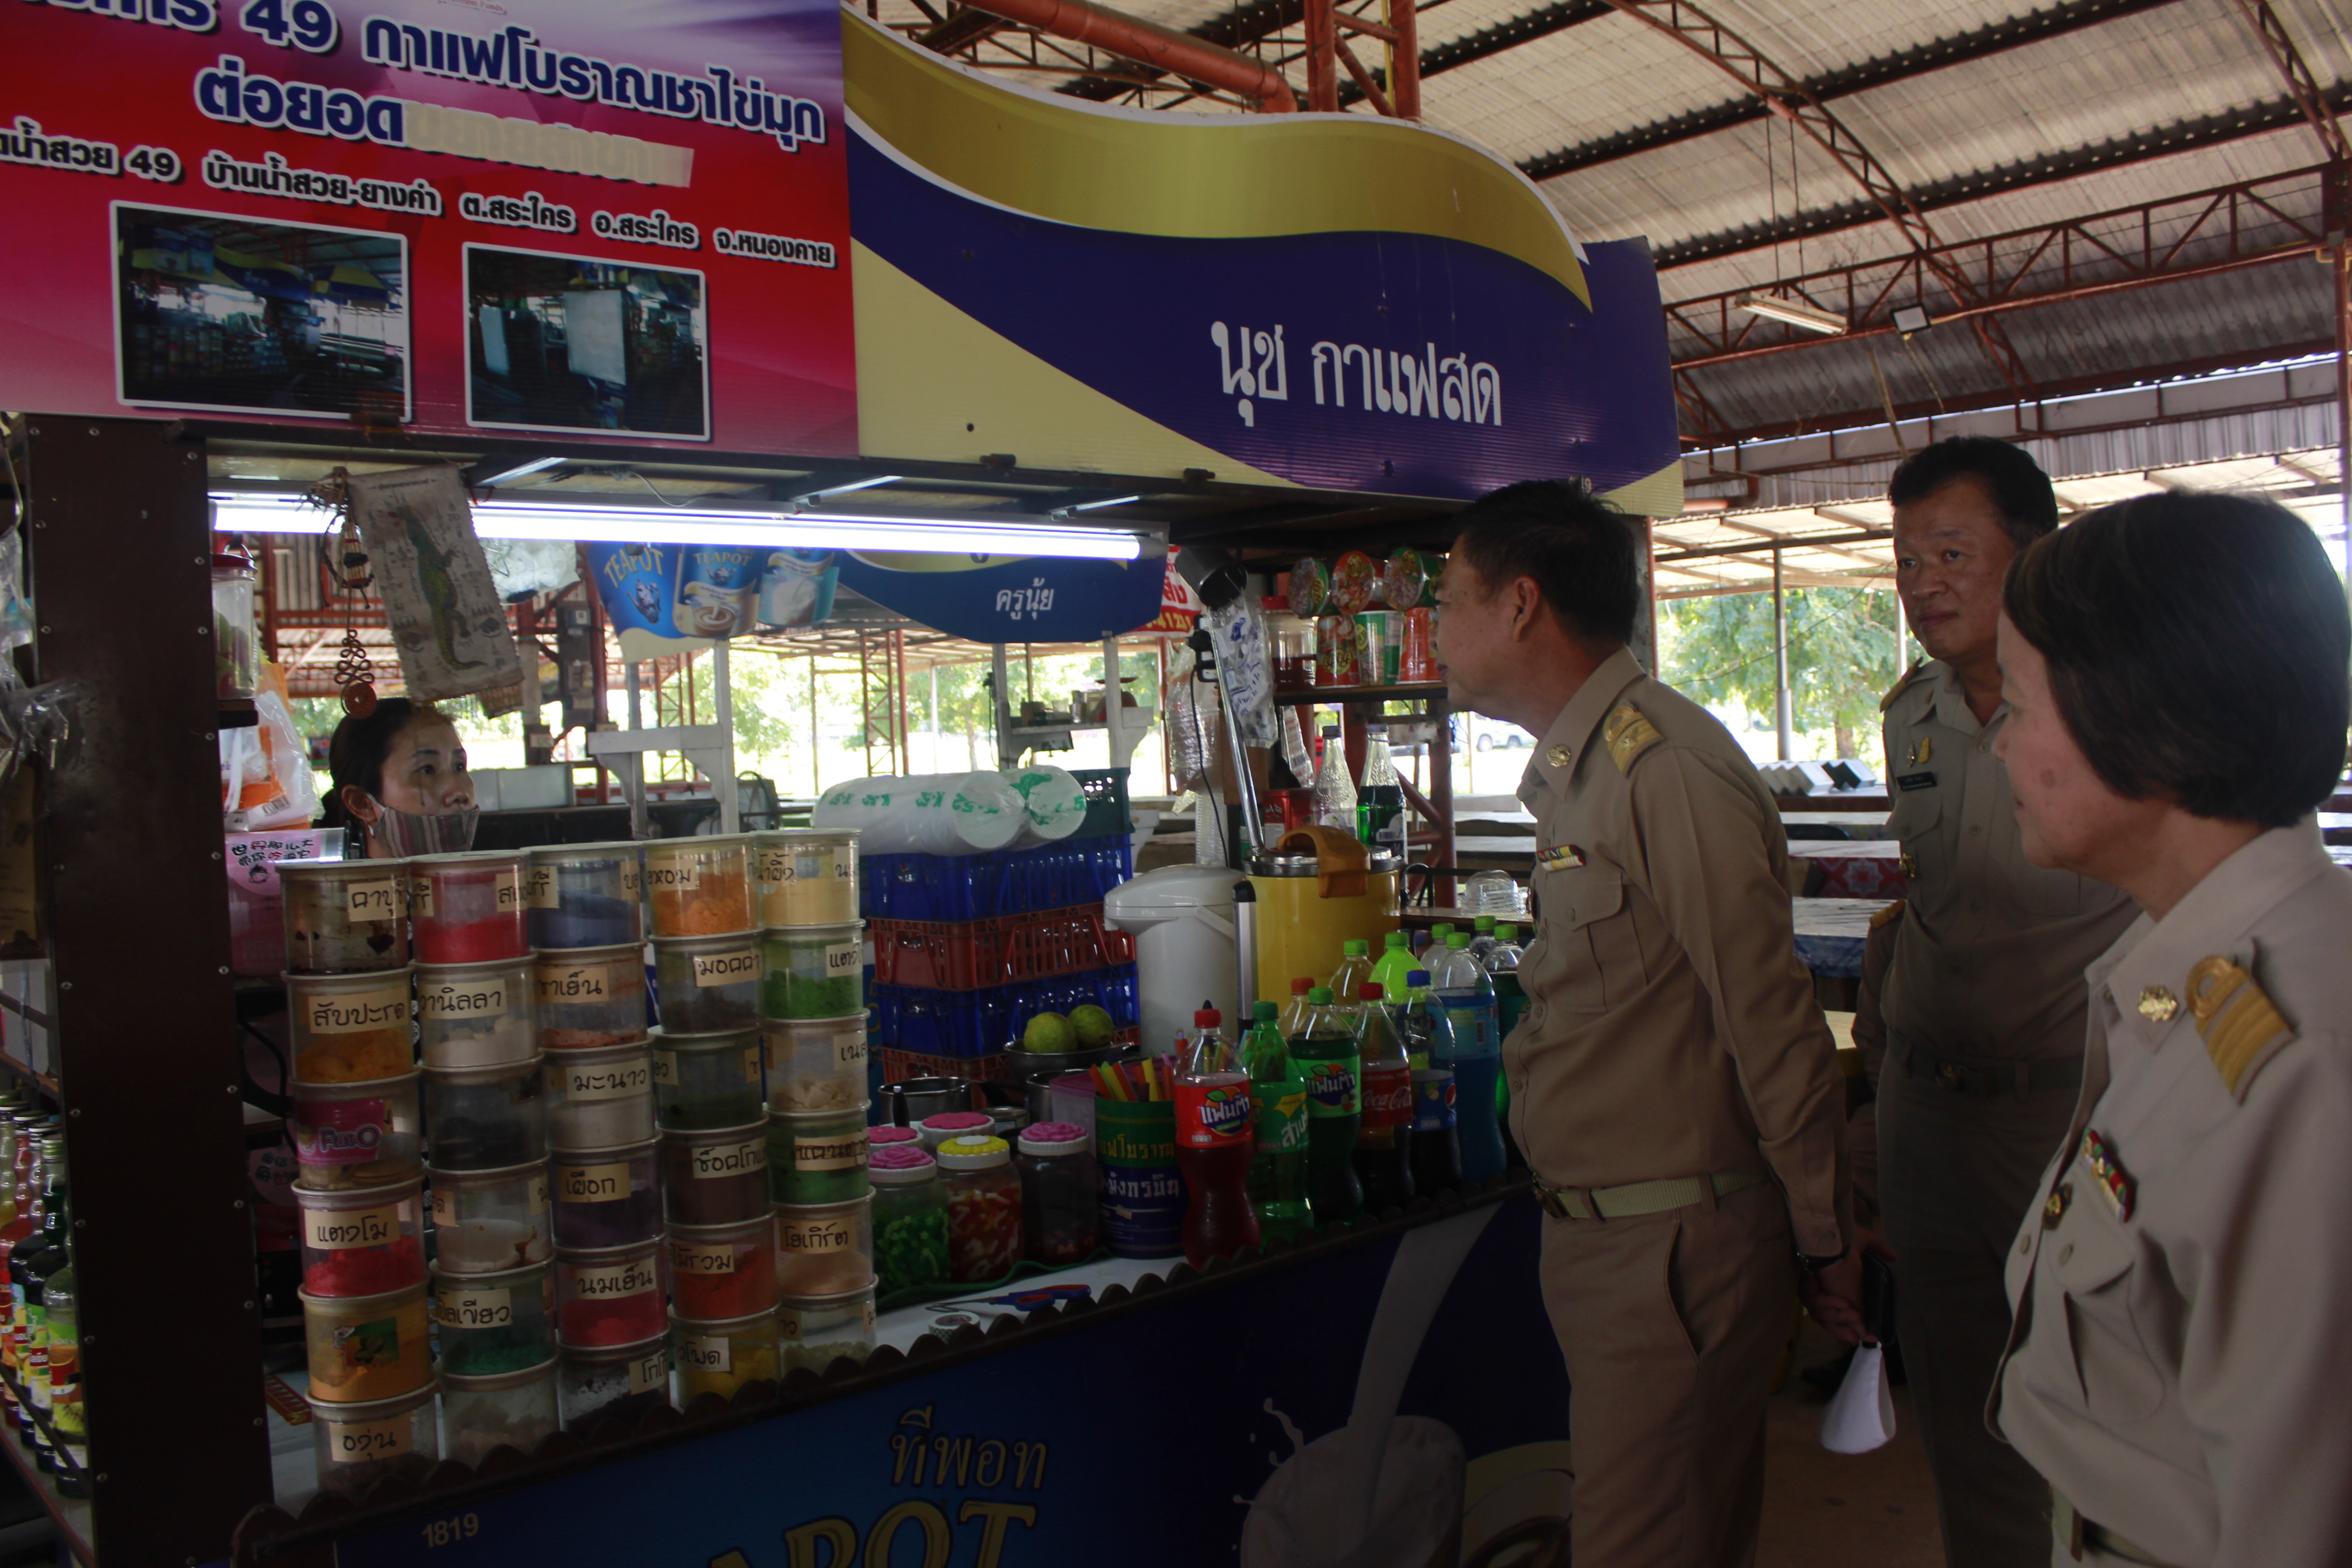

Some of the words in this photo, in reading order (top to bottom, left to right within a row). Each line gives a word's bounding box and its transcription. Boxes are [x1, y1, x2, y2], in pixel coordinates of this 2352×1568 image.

[245, 0, 332, 48] 49
[367, 19, 822, 147] กาแฟโบราณชาไข่มุก
[131, 150, 174, 176] 49
[207, 153, 436, 211] บ้านน้ำสวย-ยางคำ
[464, 196, 572, 228] ต.สระใคร
[596, 214, 694, 245] อ.สระใคร
[718, 231, 831, 263] จ.หนองคาย
[1211, 321, 1288, 427] นุช
[1312, 342, 1501, 426] กาแฟสด
[693, 551, 752, 567] TEAPOT
[996, 578, 1054, 620] ครูนุ้ย
[314, 1002, 405, 1026] สับปะรด
[574, 1069, 646, 1091] มะนาว
[1307, 1070, 1355, 1095] แฟนต้า
[1200, 1093, 1250, 1124] แฟนต้า
[566, 1170, 615, 1195] เผือก
[784, 1223, 848, 1248] โยเกิร์ต
[578, 1263, 652, 1294] นมเย็น
[891, 1405, 1047, 1489] ทีพอท
[421, 1513, 480, 1548] 1819
